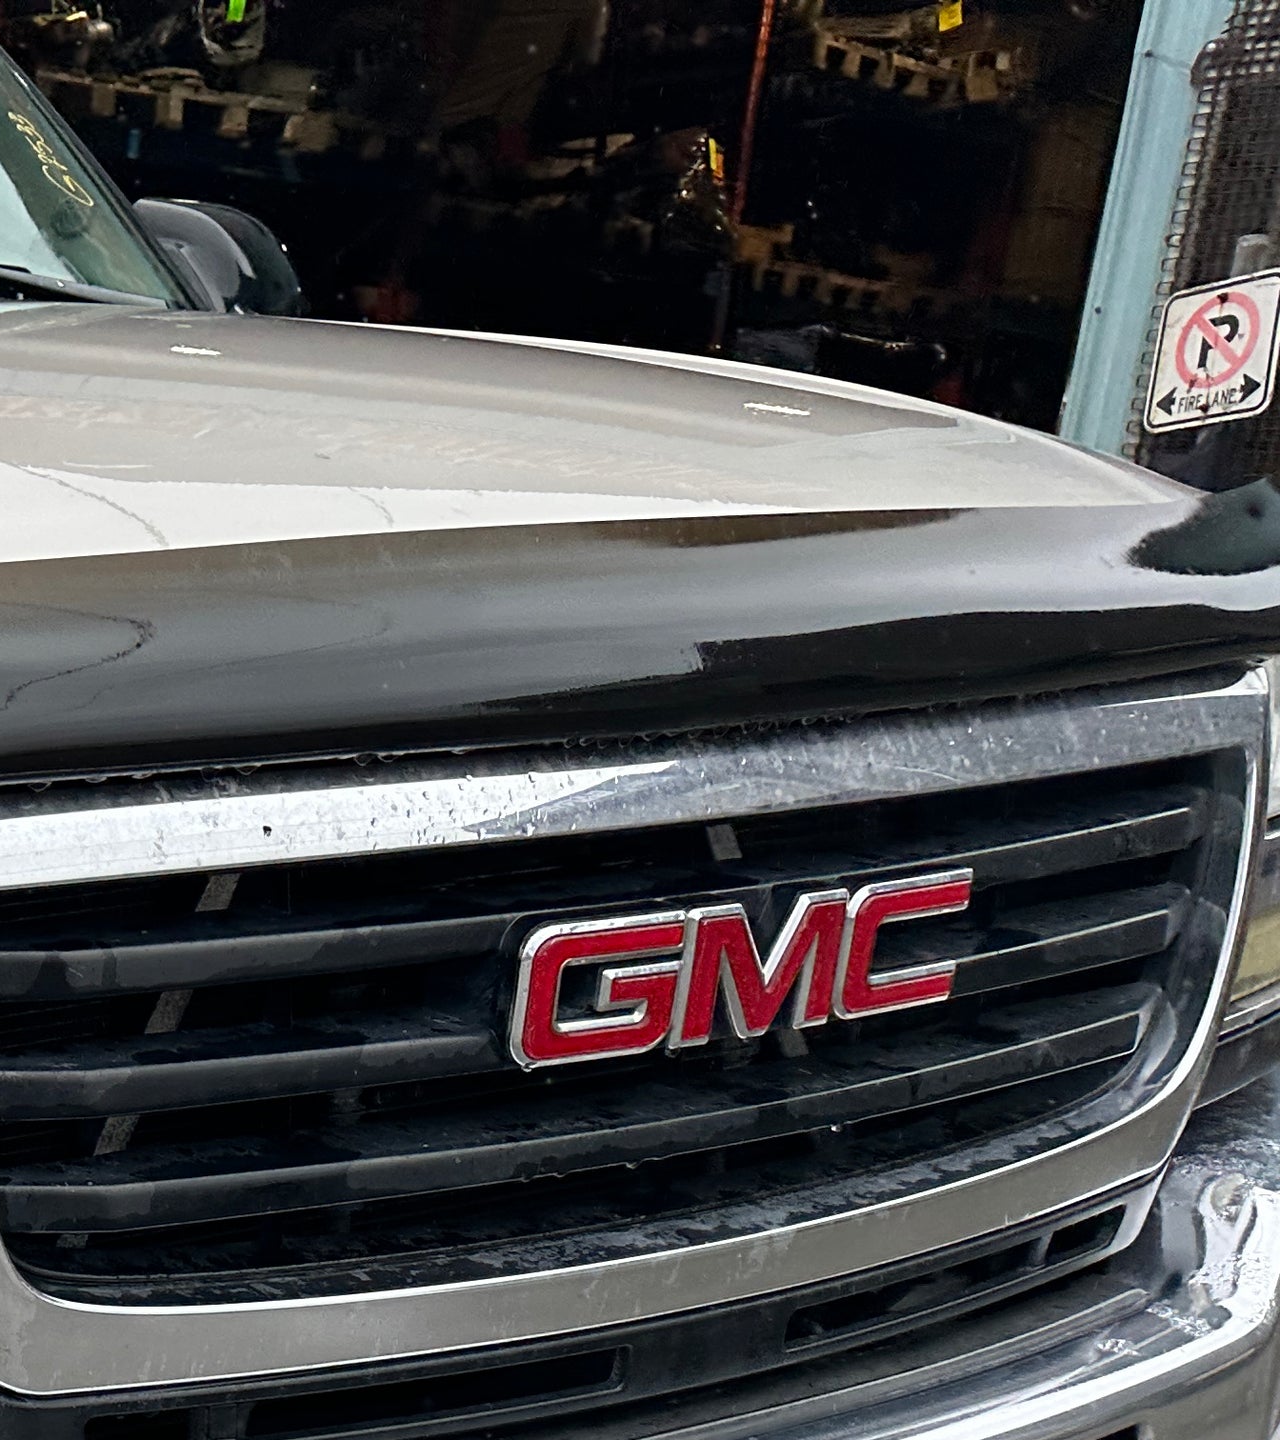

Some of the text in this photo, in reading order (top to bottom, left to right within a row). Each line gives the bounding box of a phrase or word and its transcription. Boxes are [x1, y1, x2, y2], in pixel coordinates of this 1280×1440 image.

[1177, 387, 1238, 413] FIRE LANE
[510, 868, 973, 1070] GMC
